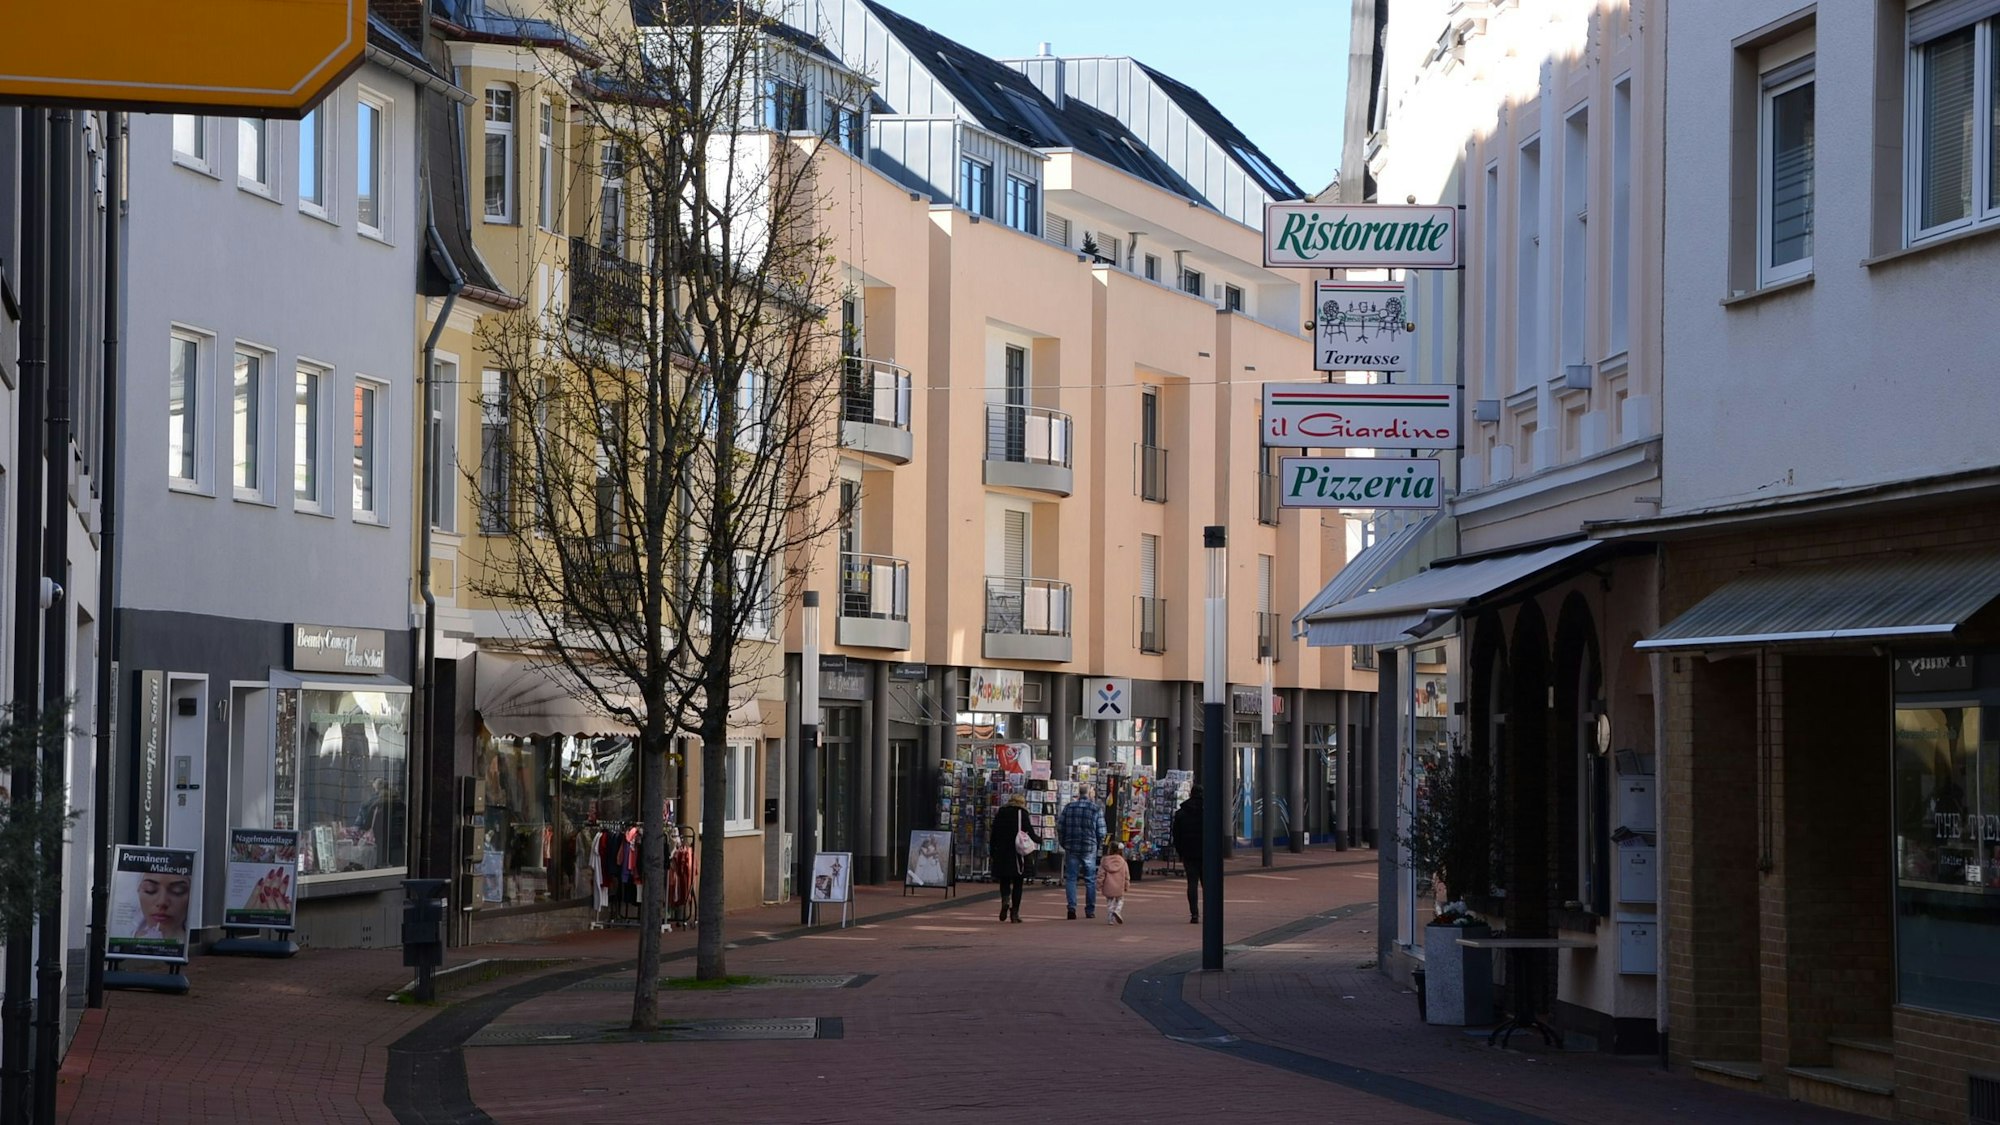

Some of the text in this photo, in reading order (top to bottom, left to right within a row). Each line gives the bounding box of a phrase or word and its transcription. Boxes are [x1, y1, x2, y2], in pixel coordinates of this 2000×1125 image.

[1275, 212, 1450, 261] Ristorante
[1323, 349, 1400, 366] Terrasse
[1271, 412, 1450, 439] il Giardino
[1288, 465, 1434, 501] Pizzeria
[297, 627, 325, 654] Beauty
[218, 699, 228, 723] 17
[1935, 812, 1960, 838] THE
[235, 834, 293, 847] Nagelmodellage
[150, 864, 188, 875] Make-up
